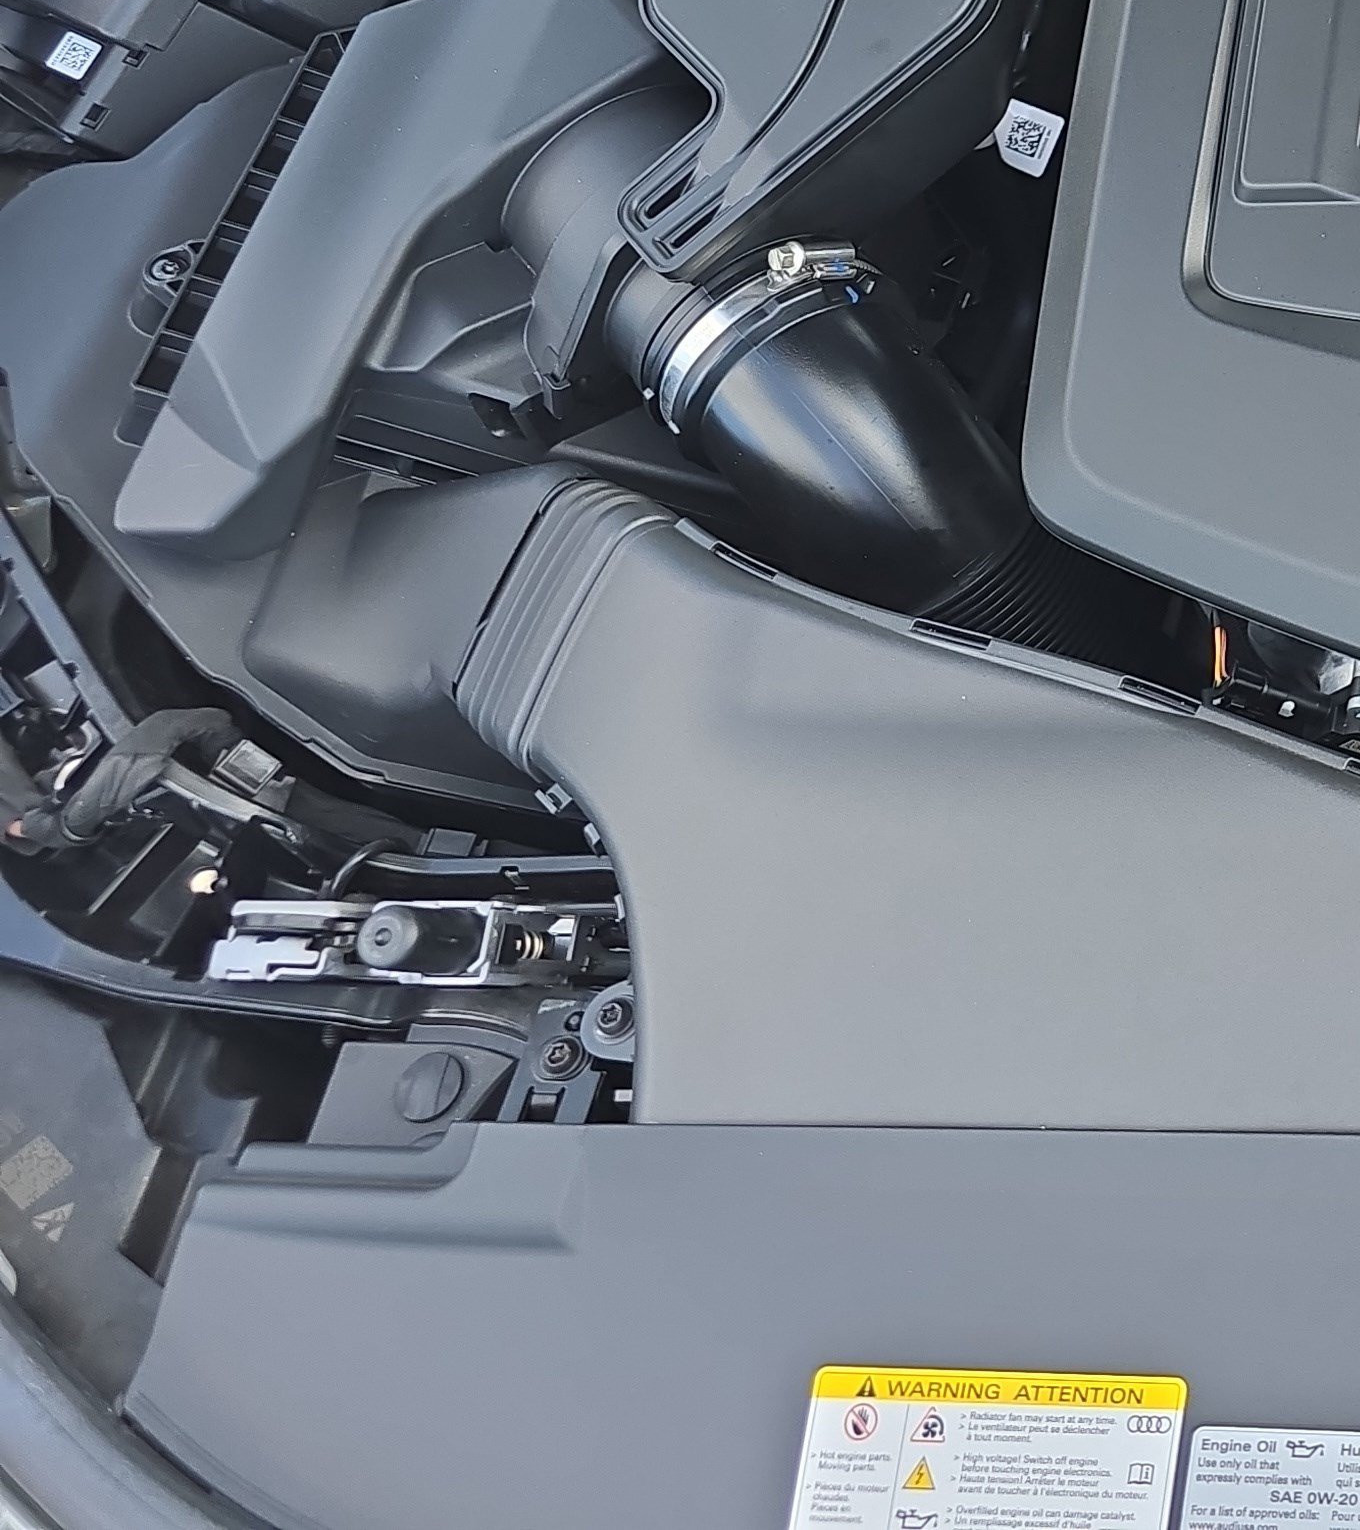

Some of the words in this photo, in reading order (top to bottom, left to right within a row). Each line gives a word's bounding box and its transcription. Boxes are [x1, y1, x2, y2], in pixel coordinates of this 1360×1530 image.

[888, 1379, 1001, 1400] WARNING
[1013, 1384, 1145, 1405] ATTENTION
[970, 1411, 1006, 1421] Radiator
[1009, 1413, 1022, 1422] fan
[1025, 1415, 1043, 1424] may
[1045, 1415, 1065, 1424] start
[1067, 1416, 1075, 1424] at
[1078, 1417, 1094, 1425] any
[1096, 1417, 1117, 1425] time.
[968, 1422, 978, 1430] Le
[981, 1423, 1025, 1432] ventilateur
[1028, 1425, 1048, 1433] peut
[1063, 1426, 1110, 1435] déclencher
[974, 1434, 991, 1442] tout
[1201, 1439, 1252, 1454] Engine
[1257, 1440, 1277, 1453] Oil
[837, 1452, 866, 1462] engine
[963, 1452, 984, 1463] High
[986, 1453, 1021, 1465] voltage!
[1024, 1454, 1053, 1465] Switch
[1055, 1456, 1067, 1465] off
[1069, 1458, 1098, 1468] engine
[961, 1463, 989, 1473] before
[992, 1464, 1029, 1476] touching
[1032, 1467, 1061, 1477] engine
[1064, 1468, 1112, 1477] electronics.
[1198, 1458, 1217, 1468] Use
[1219, 1458, 1242, 1470] only
[1244, 1459, 1257, 1469] oil
[1260, 1460, 1280, 1470] that
[959, 1474, 985, 1483] Haute
[988, 1475, 1023, 1484] tension!
[1068, 1479, 1099, 1487] moteur
[1196, 1473, 1242, 1485] expressly
[1244, 1474, 1288, 1485] complies
[1291, 1475, 1312, 1486] with
[1336, 1478, 1352, 1490] qui
[958, 1485, 982, 1494] avant
[985, 1485, 996, 1494] de
[998, 1486, 1030, 1495] toucher
[1102, 1490, 1113, 1498] du
[1270, 1490, 1302, 1504] SAE
[1307, 1491, 1358, 1506] 0W-20
[956, 1505, 998, 1516] Overfilled
[1000, 1508, 1030, 1518] engine
[1032, 1507, 1043, 1516] oil
[1063, 1510, 1098, 1520] damage
[1191, 1505, 1207, 1515] For
[1218, 1505, 1233, 1516] list
[1236, 1506, 1247, 1516] of
[1249, 1508, 1295, 1520] approved
[1298, 1510, 1320, 1520] oils:
[1331, 1511, 1355, 1521] Pour
[969, 1517, 1022, 1528] remplissage
[1025, 1518, 1060, 1528] excessif
